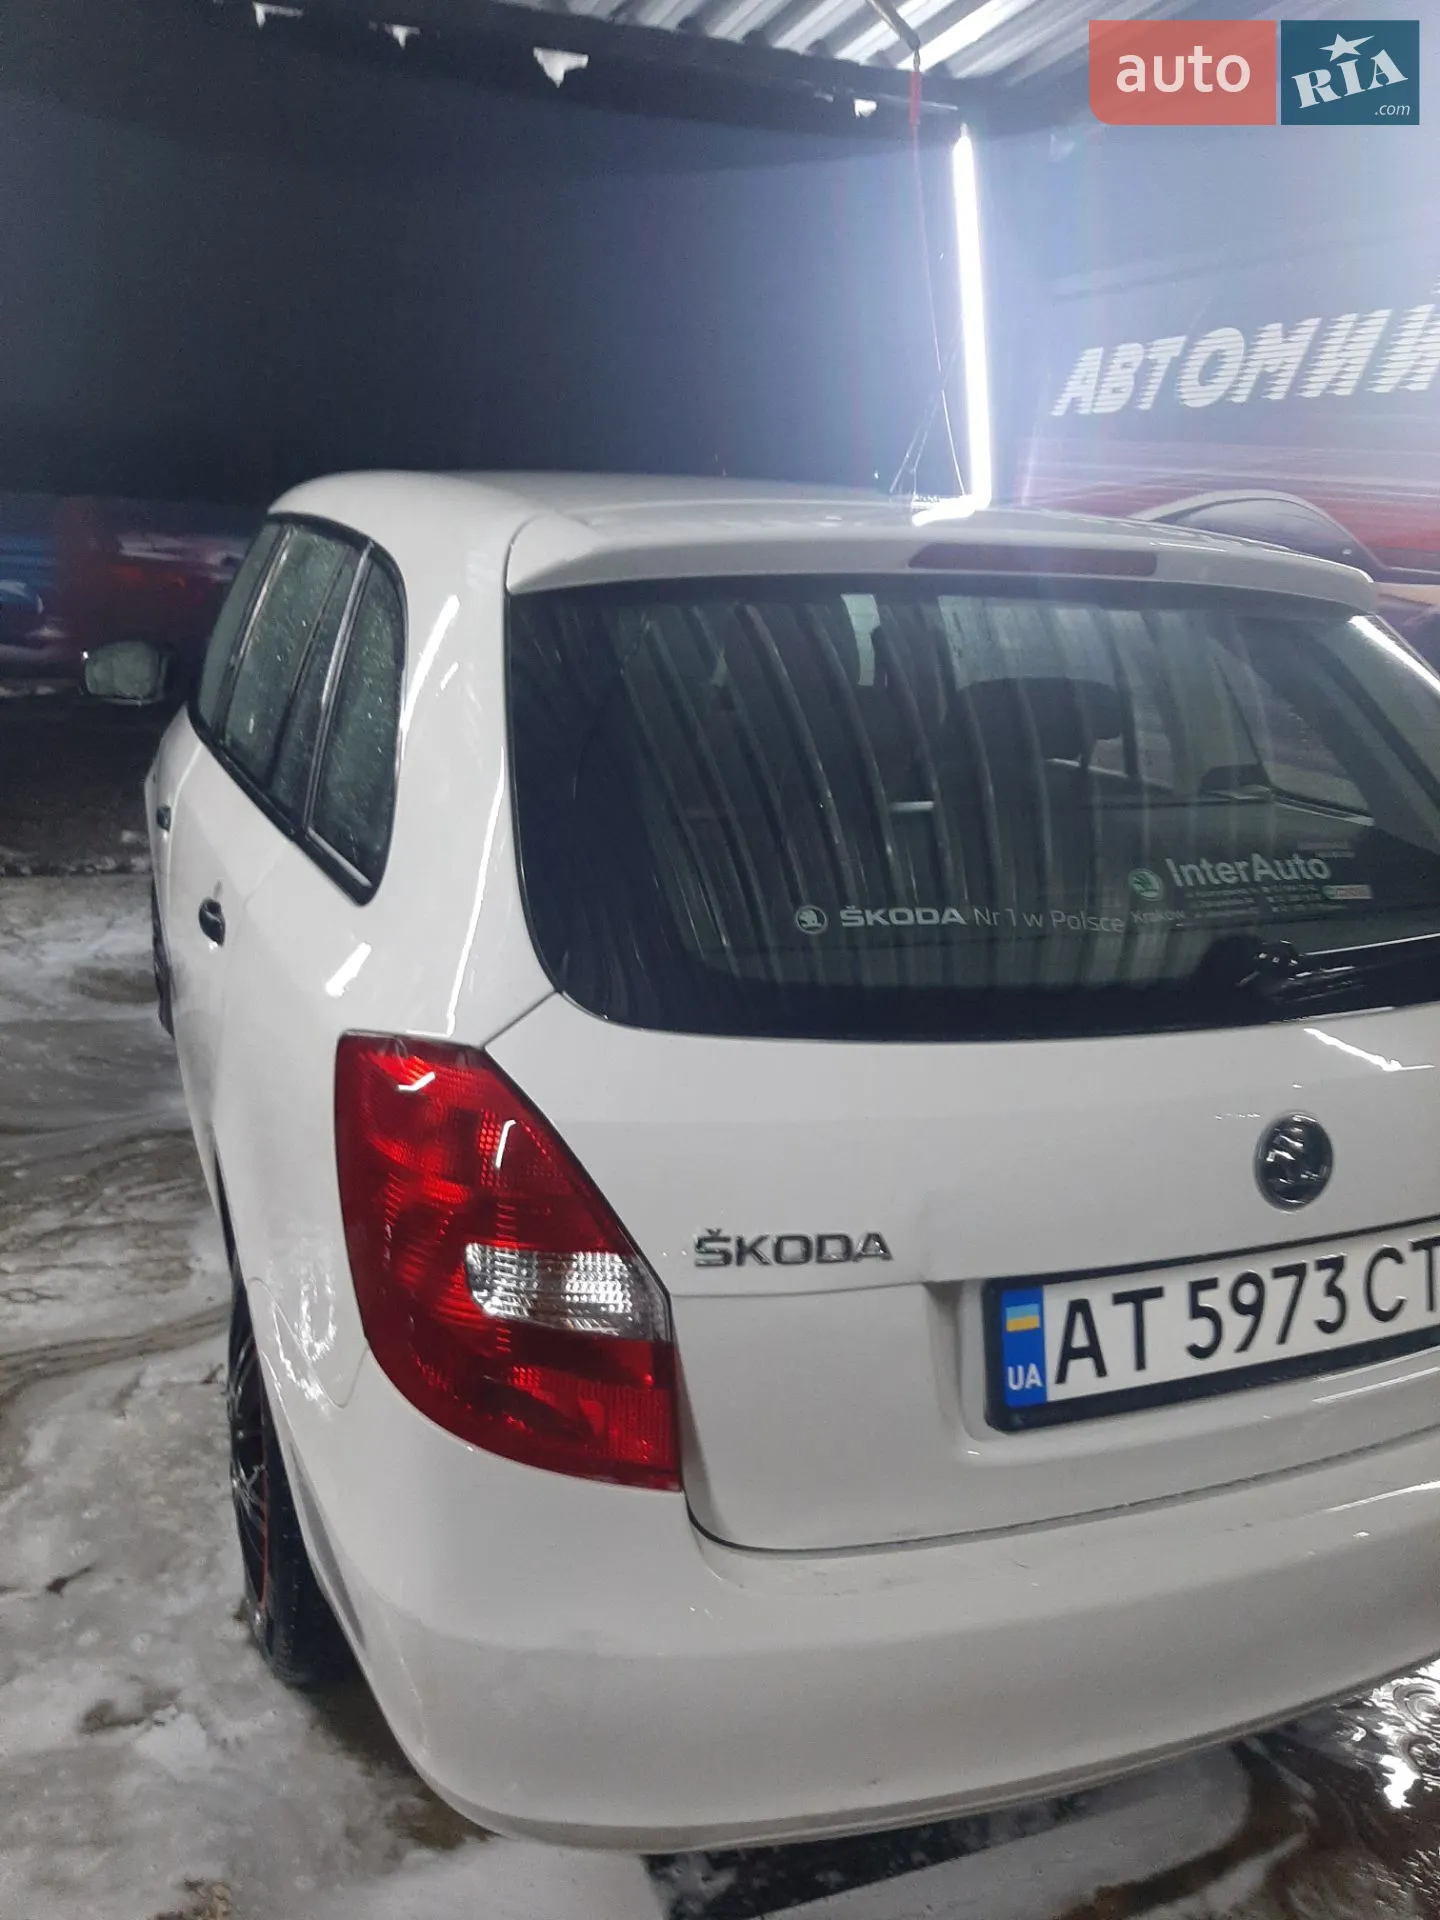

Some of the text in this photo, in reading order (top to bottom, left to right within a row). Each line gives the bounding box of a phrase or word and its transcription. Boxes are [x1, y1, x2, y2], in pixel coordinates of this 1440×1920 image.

[1165, 852, 1332, 888] InterAuto
[841, 906, 1125, 933] ŠKODA Nr 1 w Polsce
[694, 1228, 894, 1267] ŠKODA
[1055, 1233, 1440, 1384] AT 5973 CT
[1007, 1363, 1042, 1390] UA
